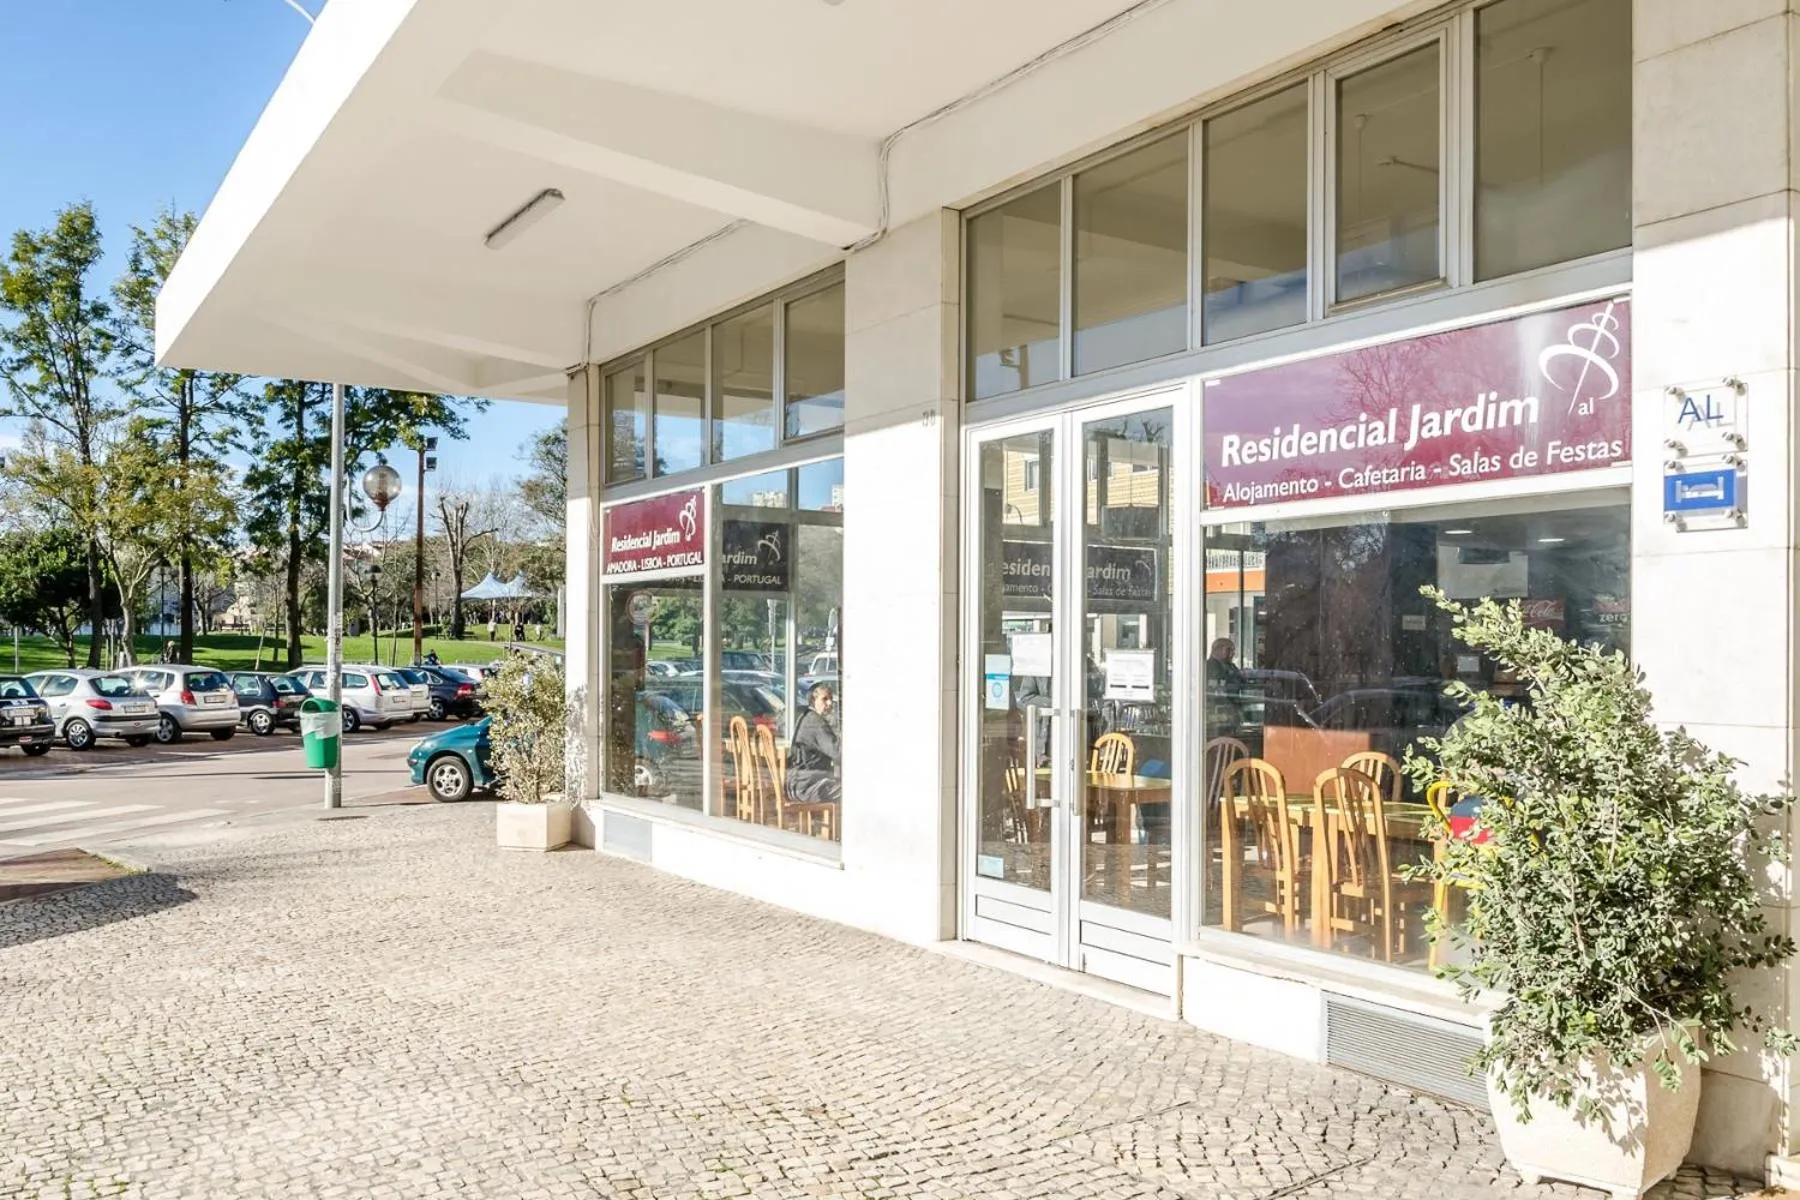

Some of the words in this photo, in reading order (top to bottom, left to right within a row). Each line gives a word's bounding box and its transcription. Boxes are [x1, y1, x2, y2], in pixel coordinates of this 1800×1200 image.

[1578, 397, 1594, 416] al
[1678, 393, 1724, 424] AL
[1221, 407, 1397, 467] Residencial
[1404, 391, 1539, 451] Jardim
[1223, 477, 1318, 504] Alojamento
[1338, 461, 1426, 489] Cafetaria
[1449, 450, 1501, 476] Salas
[1509, 446, 1538, 468] de
[1547, 439, 1623, 465] Festas
[611, 531, 652, 552] Residencial
[652, 527, 680, 551] Jardim
[606, 559, 637, 574] AMADORA
[641, 556, 663, 570] LISBOA
[666, 551, 703, 567] PORTUGAL
[721, 552, 758, 565] ardim
[733, 574, 783, 585] PORTUGAL
[1088, 562, 1131, 581] ardim
[1599, 613, 1628, 625] zero
